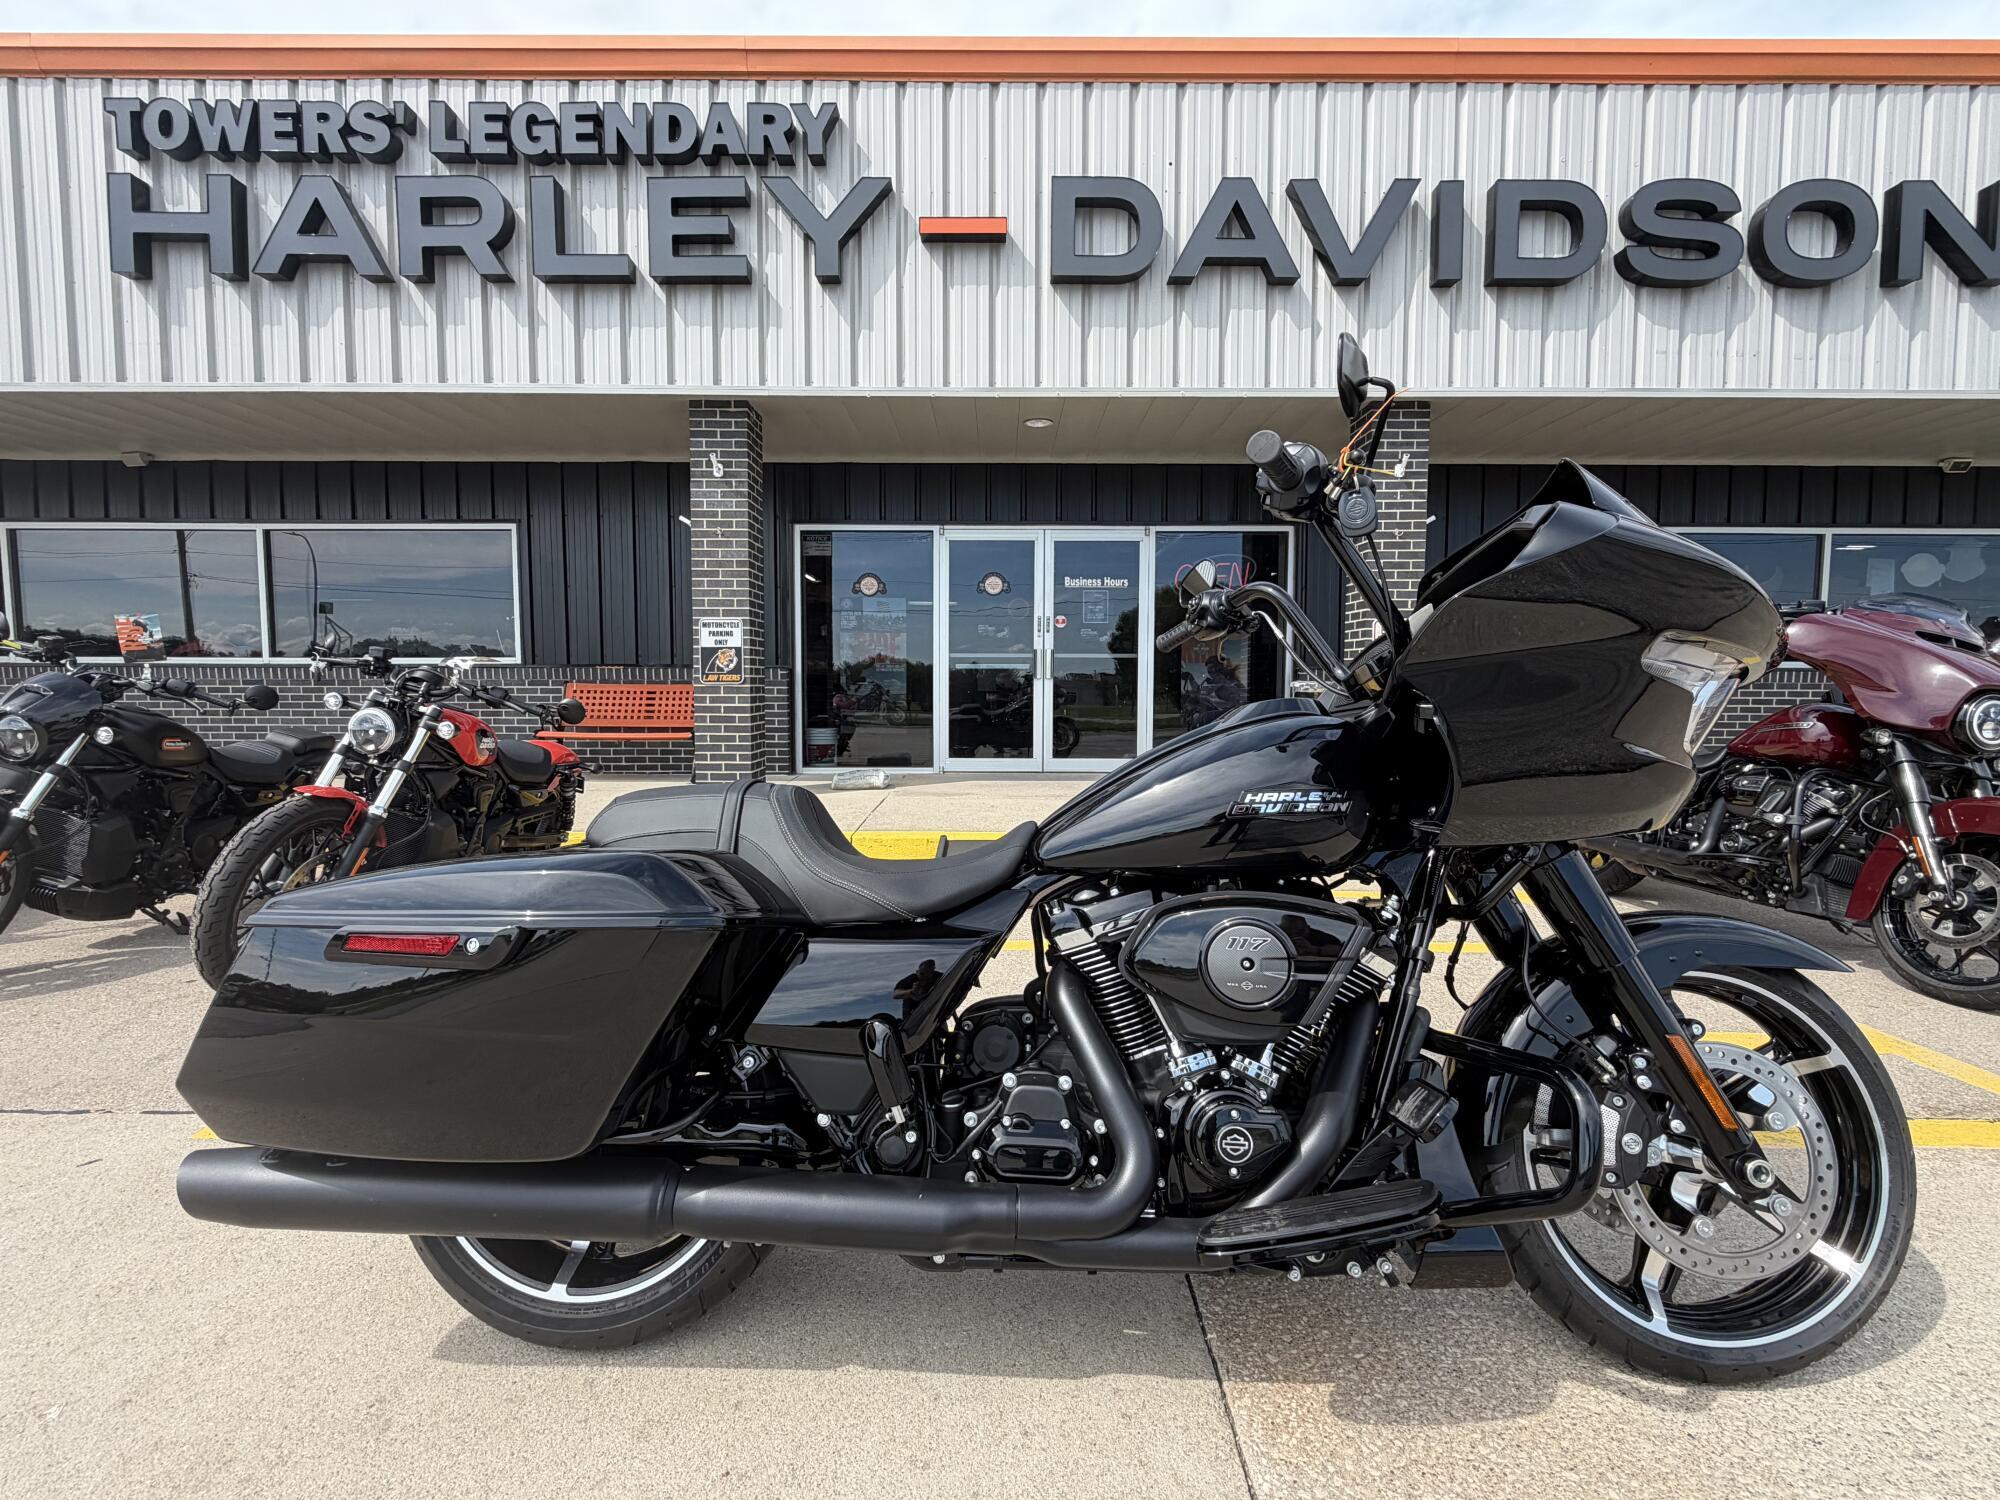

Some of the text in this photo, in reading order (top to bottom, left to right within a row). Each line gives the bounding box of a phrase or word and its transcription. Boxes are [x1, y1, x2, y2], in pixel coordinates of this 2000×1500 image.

[103, 98, 839, 166] TOWERS' LEGENDARY
[1064, 576, 1129, 588] Business Hours
[1231, 802, 1349, 815] DAVIDSON
[1226, 936, 1271, 951] 117
